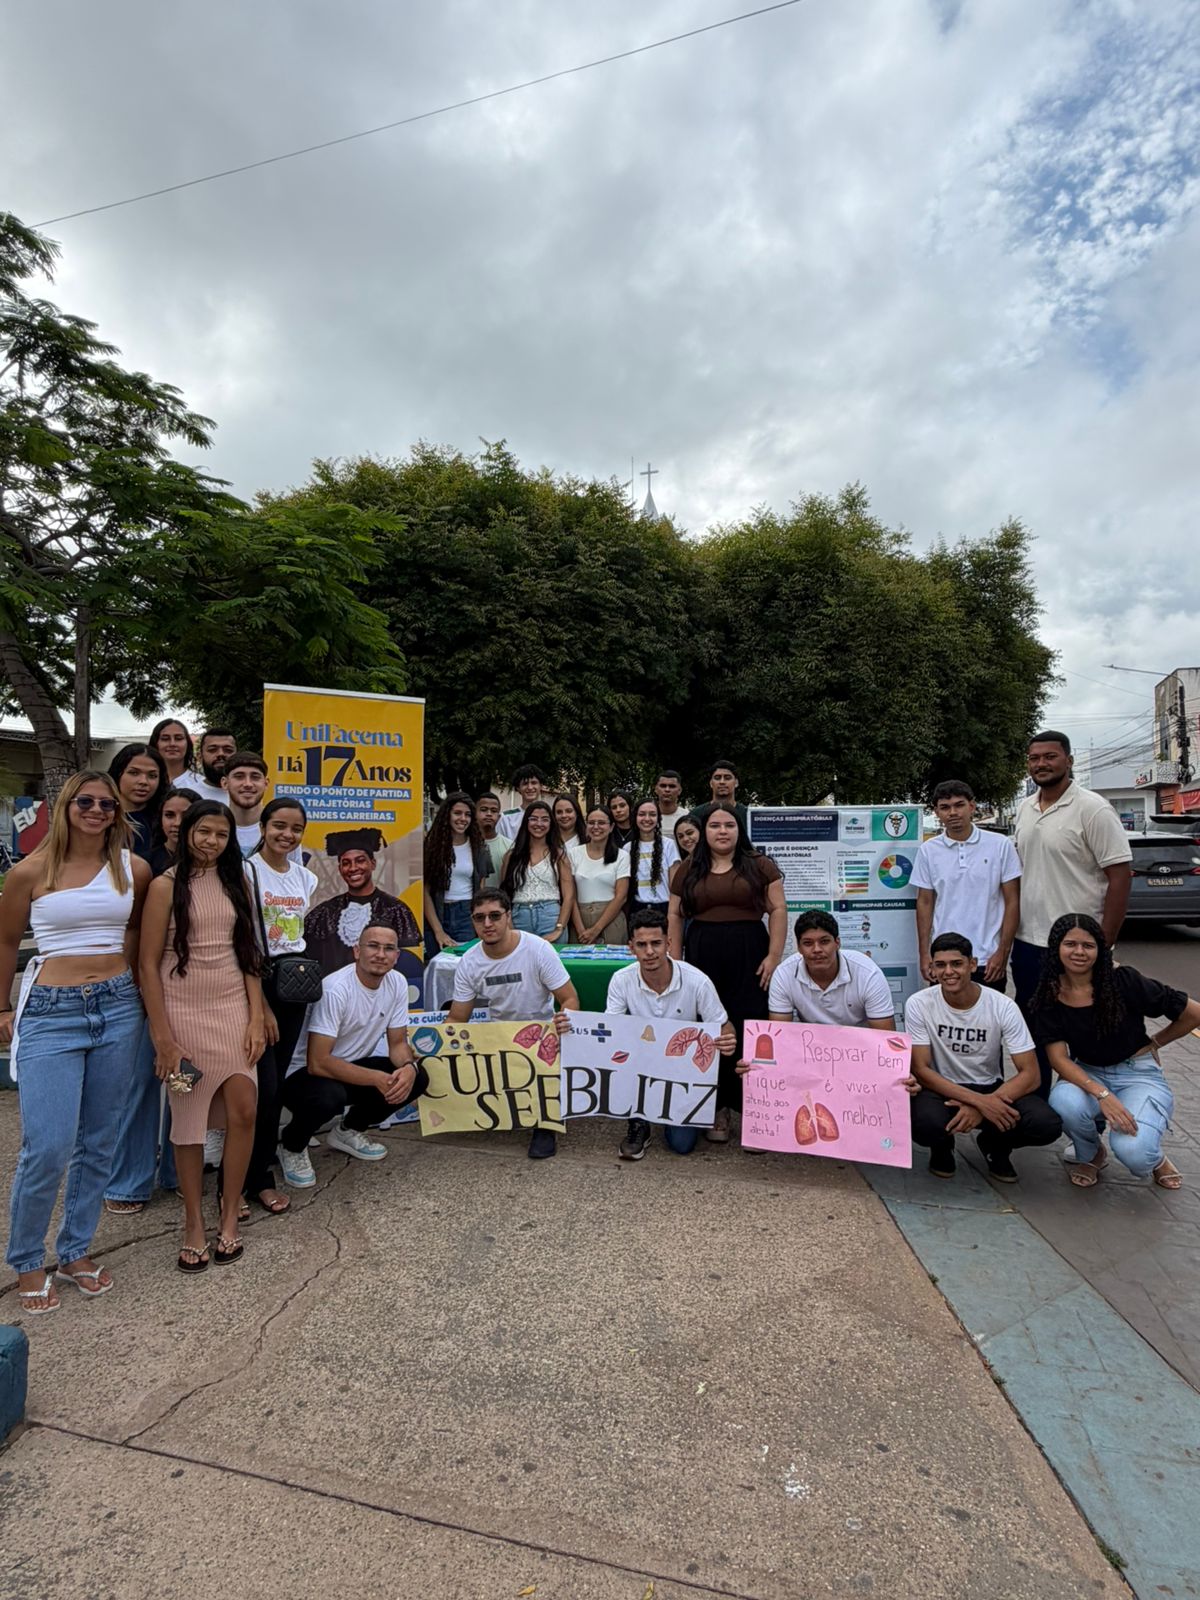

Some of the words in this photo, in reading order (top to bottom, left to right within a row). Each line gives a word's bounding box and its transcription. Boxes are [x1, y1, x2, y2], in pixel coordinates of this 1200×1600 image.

[286, 720, 403, 748] UniFacema
[277, 754, 303, 773] Há
[298, 745, 356, 787] 17
[349, 759, 412, 783] Anos
[277, 785, 312, 795] SENDO
[312, 786, 320, 795] O
[321, 787, 355, 796] PONTO
[356, 788, 369, 797] DE
[369, 789, 410, 798] PARTIDA
[307, 798, 371, 809] TRAJETÓRIAS
[306, 811, 338, 820] ANDES
[339, 811, 395, 821] CARREIRAS.
[569, 1027, 589, 1035] SUS
[937, 1024, 987, 1042] FITCH
[801, 1030, 868, 1077] Respirar
[877, 1044, 904, 1071] bem
[824, 1079, 834, 1093] é
[846, 1083, 878, 1094] viver
[562, 1066, 719, 1126] BLITZ
[774, 1111, 785, 1121] de
